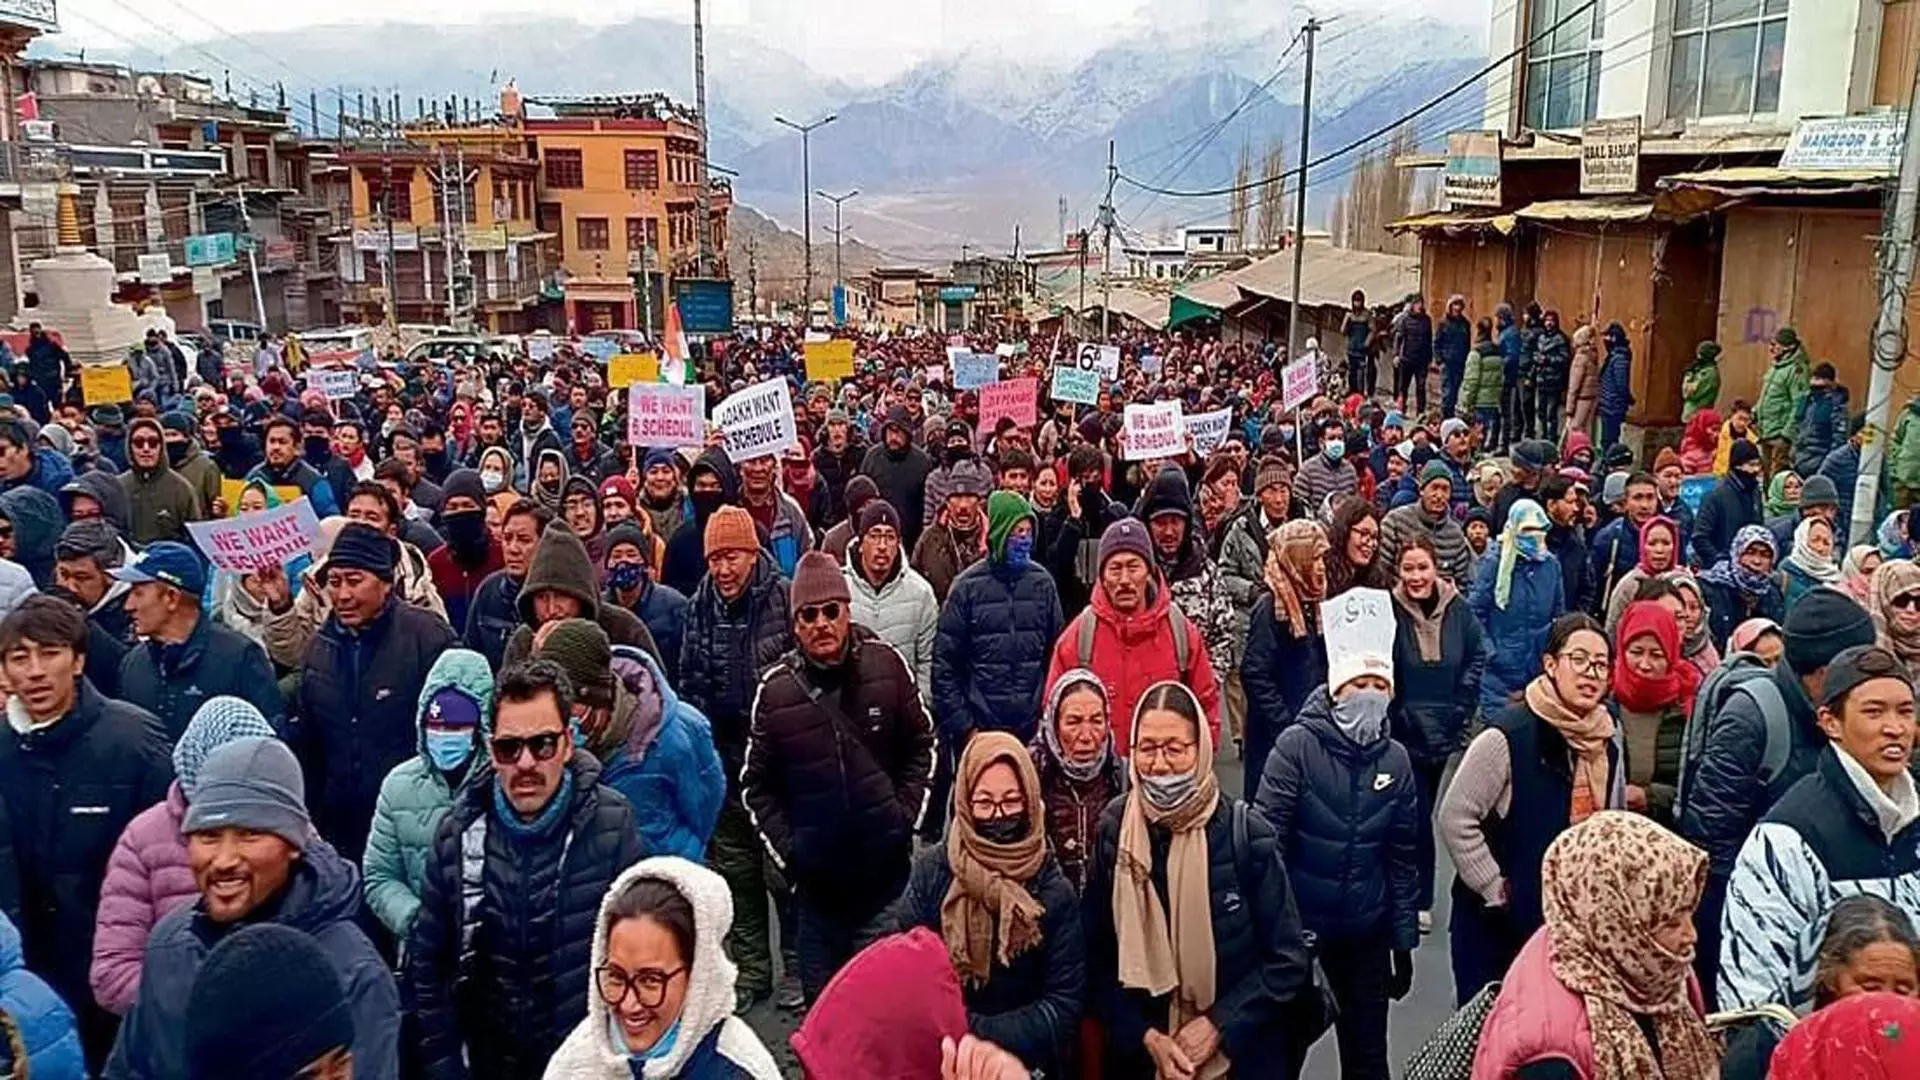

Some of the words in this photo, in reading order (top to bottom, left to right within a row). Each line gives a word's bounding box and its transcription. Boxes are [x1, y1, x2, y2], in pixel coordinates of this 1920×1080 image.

[641, 394, 658, 414] WE
[661, 397, 694, 414] WANT
[752, 390, 782, 417] WANT
[1132, 413, 1146, 430] WE
[1148, 411, 1172, 430] WANT
[731, 419, 783, 451] SCHEDULE
[210, 530, 244, 551] WE
[242, 514, 301, 548] WANT
